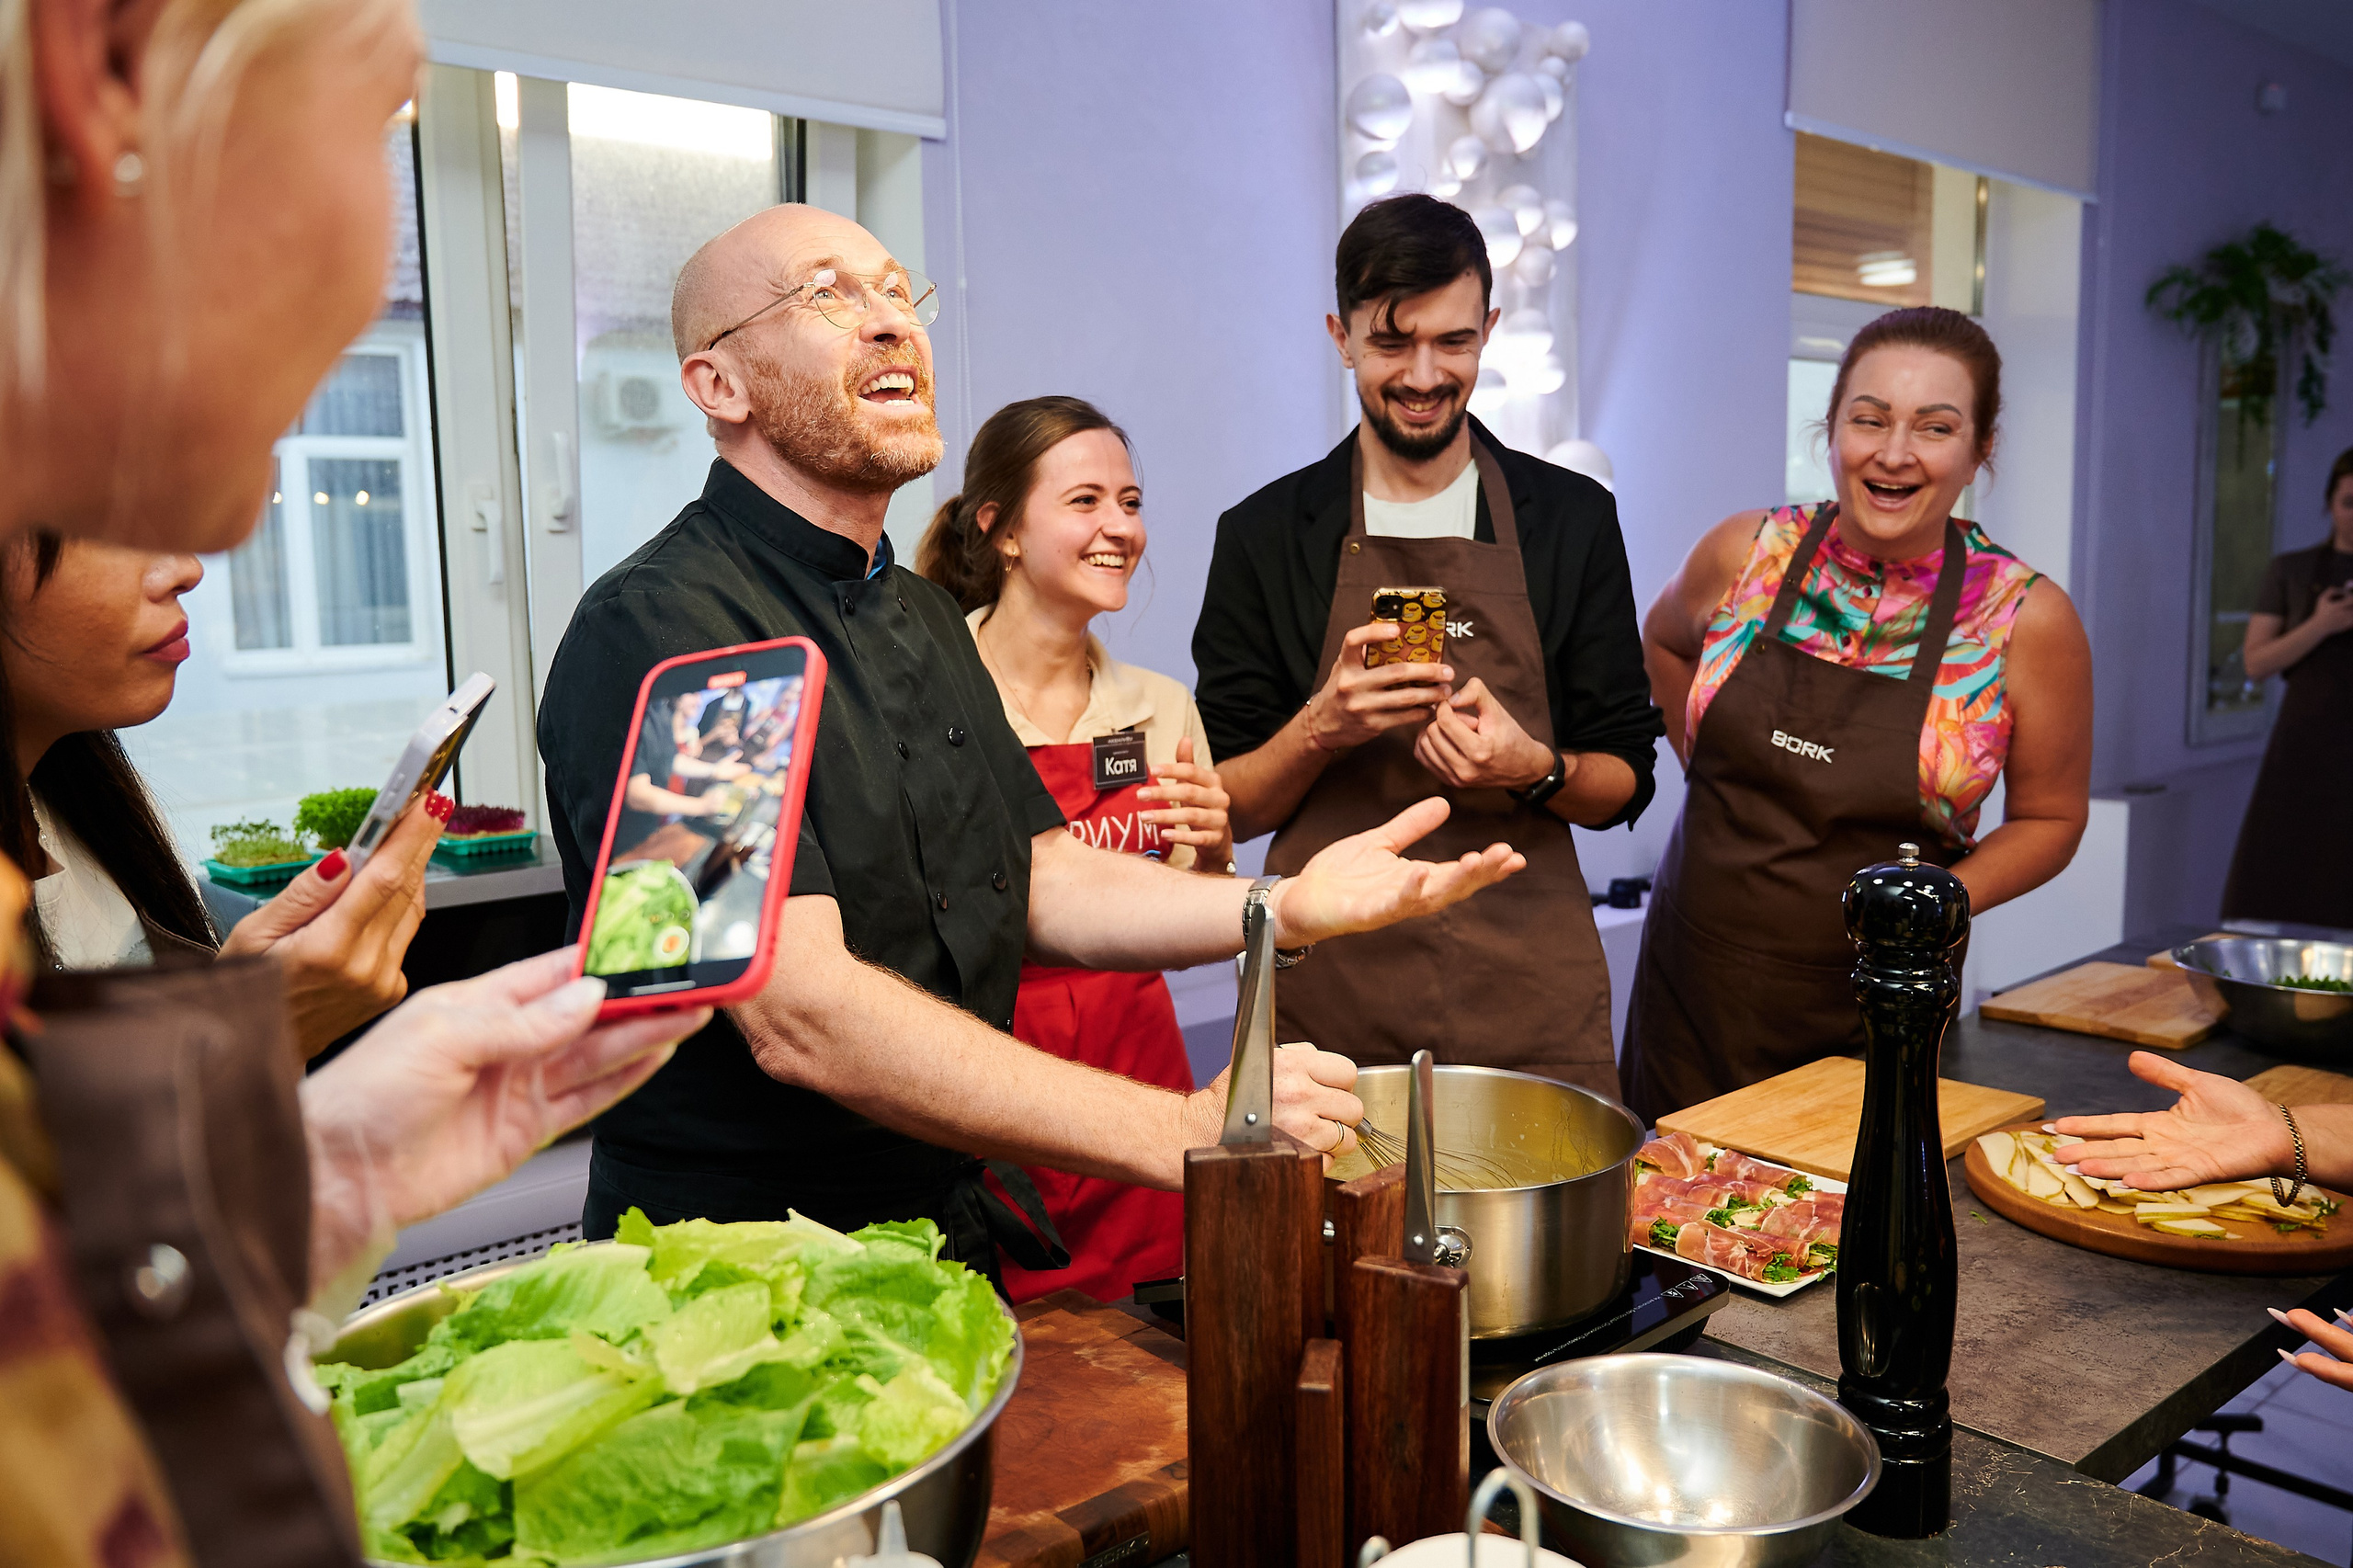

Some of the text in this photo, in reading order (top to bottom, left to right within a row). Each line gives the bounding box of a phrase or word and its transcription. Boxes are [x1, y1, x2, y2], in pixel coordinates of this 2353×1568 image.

[1446, 620, 1474, 638] RK
[1770, 729, 1835, 764] BORK
[1105, 756, 1137, 776] Катя
[1069, 810, 1159, 852] РИУМ
